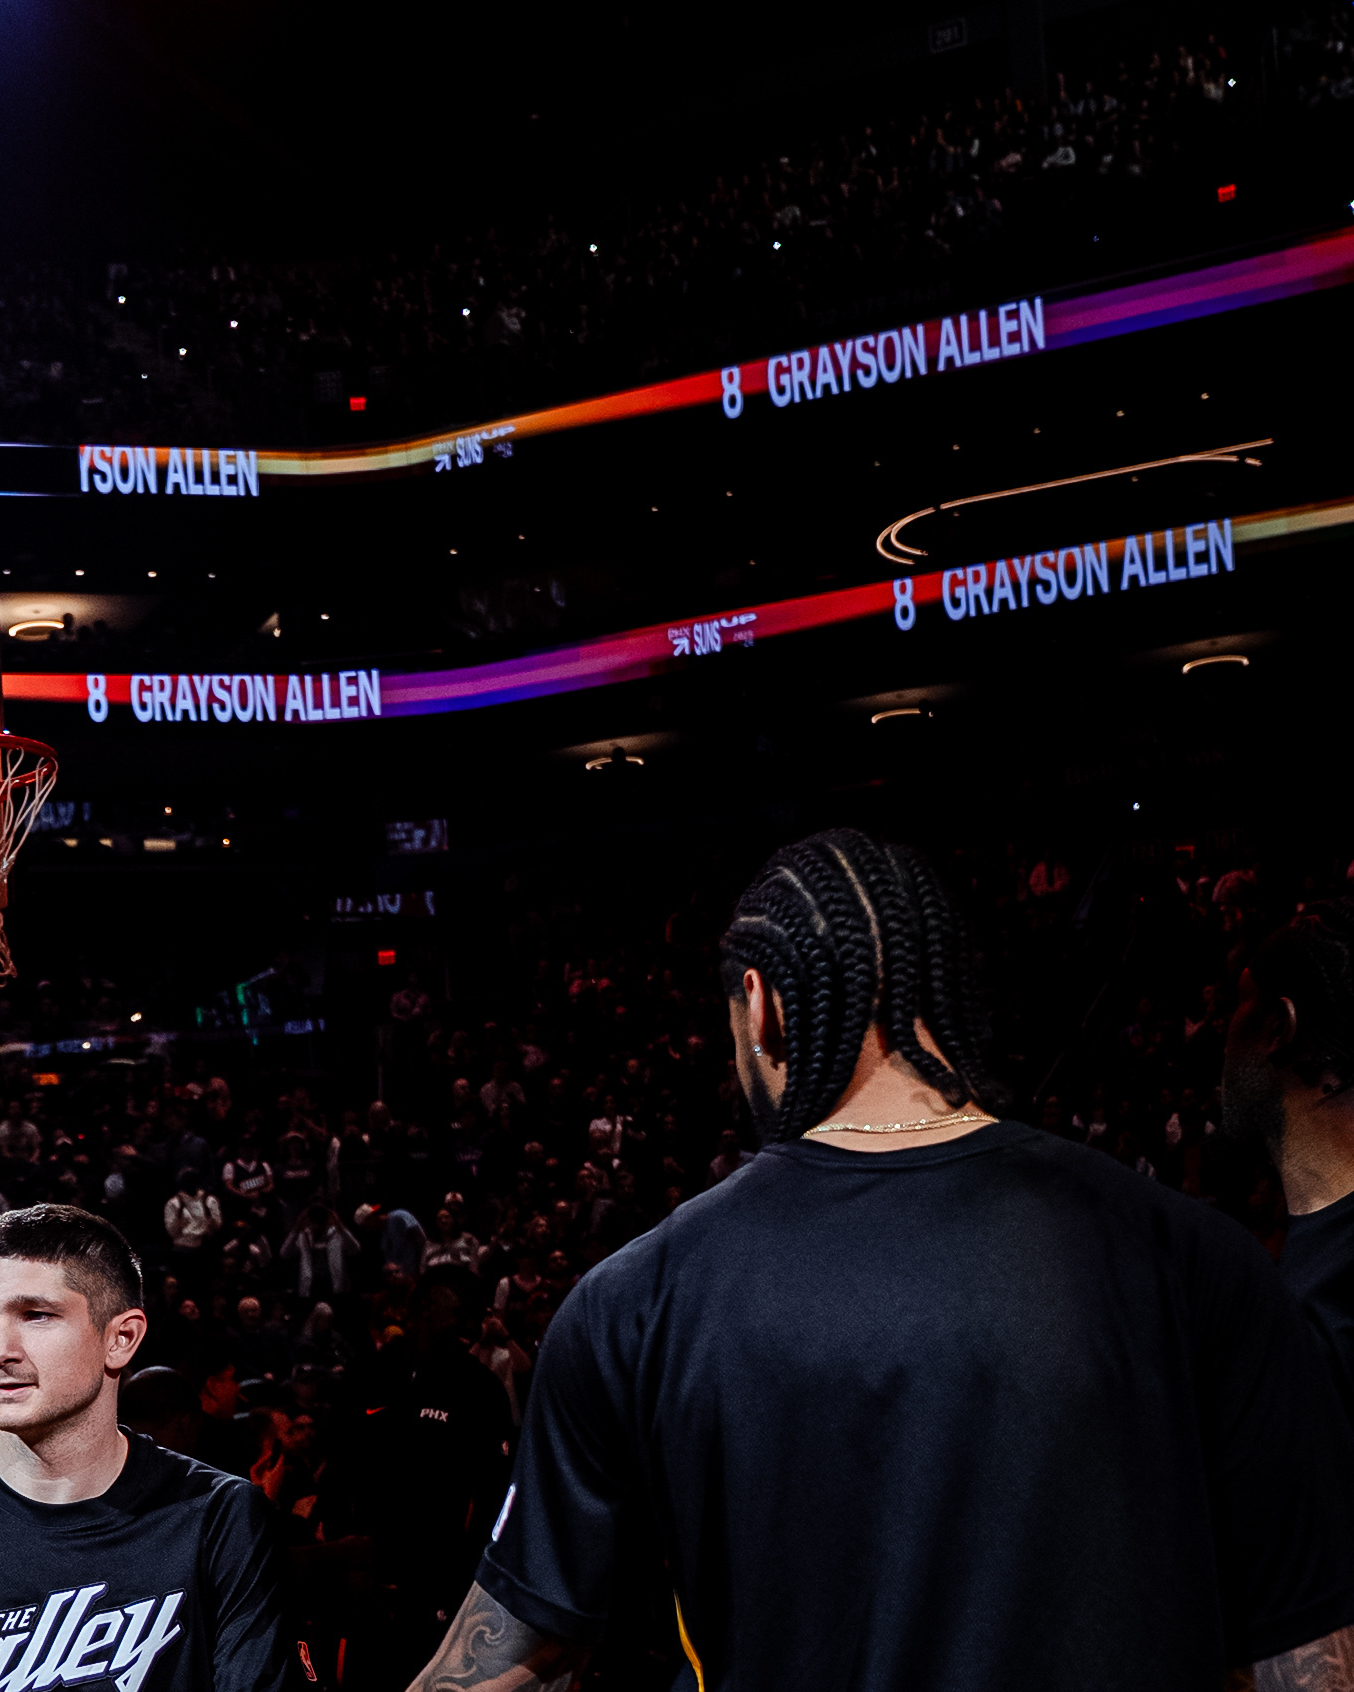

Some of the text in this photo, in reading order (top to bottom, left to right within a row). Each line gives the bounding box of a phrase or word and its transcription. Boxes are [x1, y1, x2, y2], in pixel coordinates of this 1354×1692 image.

[722, 366, 744, 418] 8
[767, 325, 926, 407] GRAYSON
[937, 297, 1045, 371] ALLEN
[79, 446, 259, 497] YSON ALLEN
[892, 518, 1235, 631] 8 GRAYSON ALLEN
[693, 620, 722, 656] SUNS
[87, 668, 381, 722] 8 GRAYSON ALLEN
[419, 1407, 449, 1423] PHX
